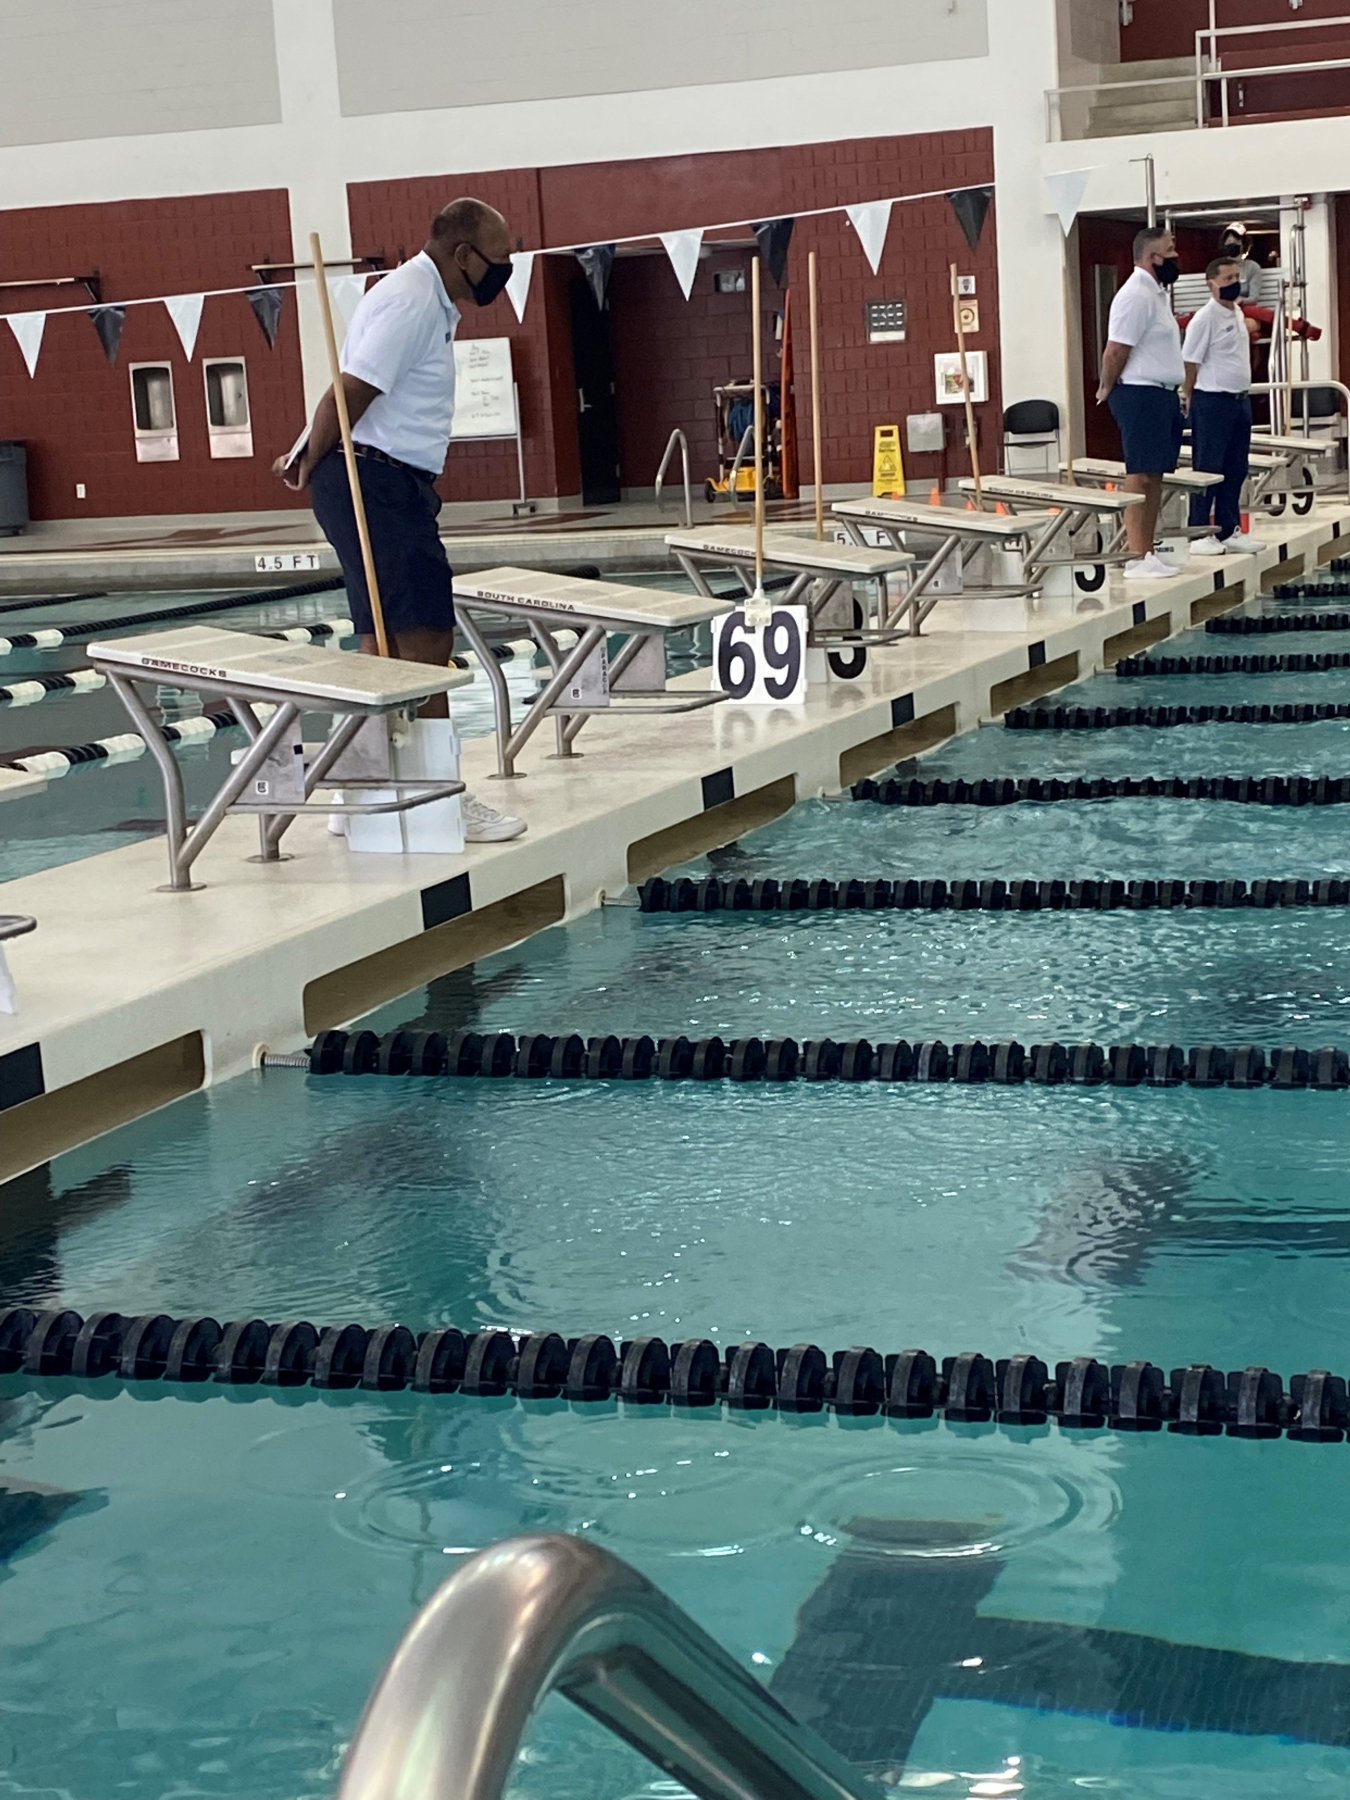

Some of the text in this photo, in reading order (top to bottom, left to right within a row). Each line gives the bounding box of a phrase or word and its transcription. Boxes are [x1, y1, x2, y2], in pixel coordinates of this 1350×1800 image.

[703, 544, 757, 557] GAMECOCK
[257, 554, 317, 570] 4.5 FT
[477, 590, 575, 611] SOUTH CAROLINA
[718, 610, 801, 700] 69
[141, 657, 227, 678] GAMECOCKS
